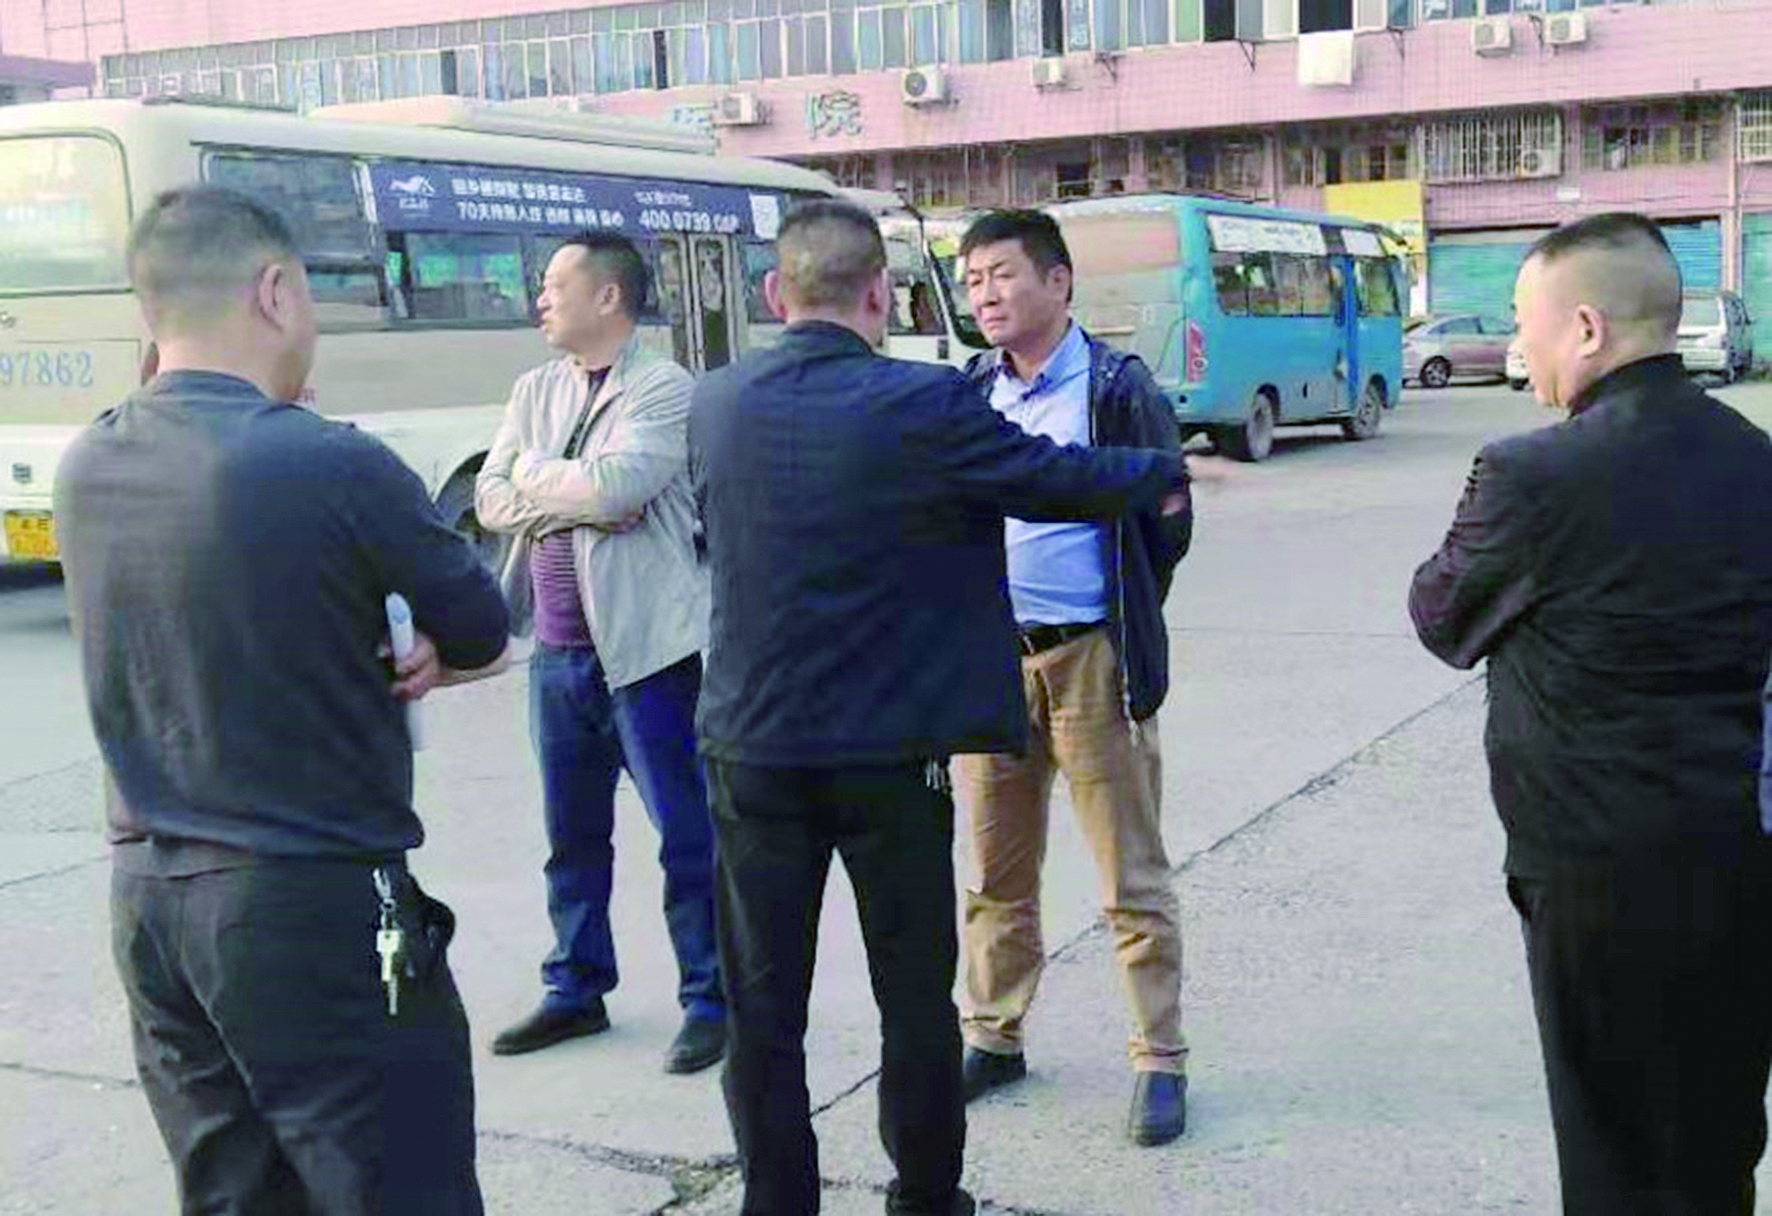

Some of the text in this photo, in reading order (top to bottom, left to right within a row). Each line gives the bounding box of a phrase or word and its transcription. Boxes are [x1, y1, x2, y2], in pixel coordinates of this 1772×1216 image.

[805, 91, 863, 141] 院
[639, 208, 671, 231] 400
[0, 350, 93, 388] 97862
